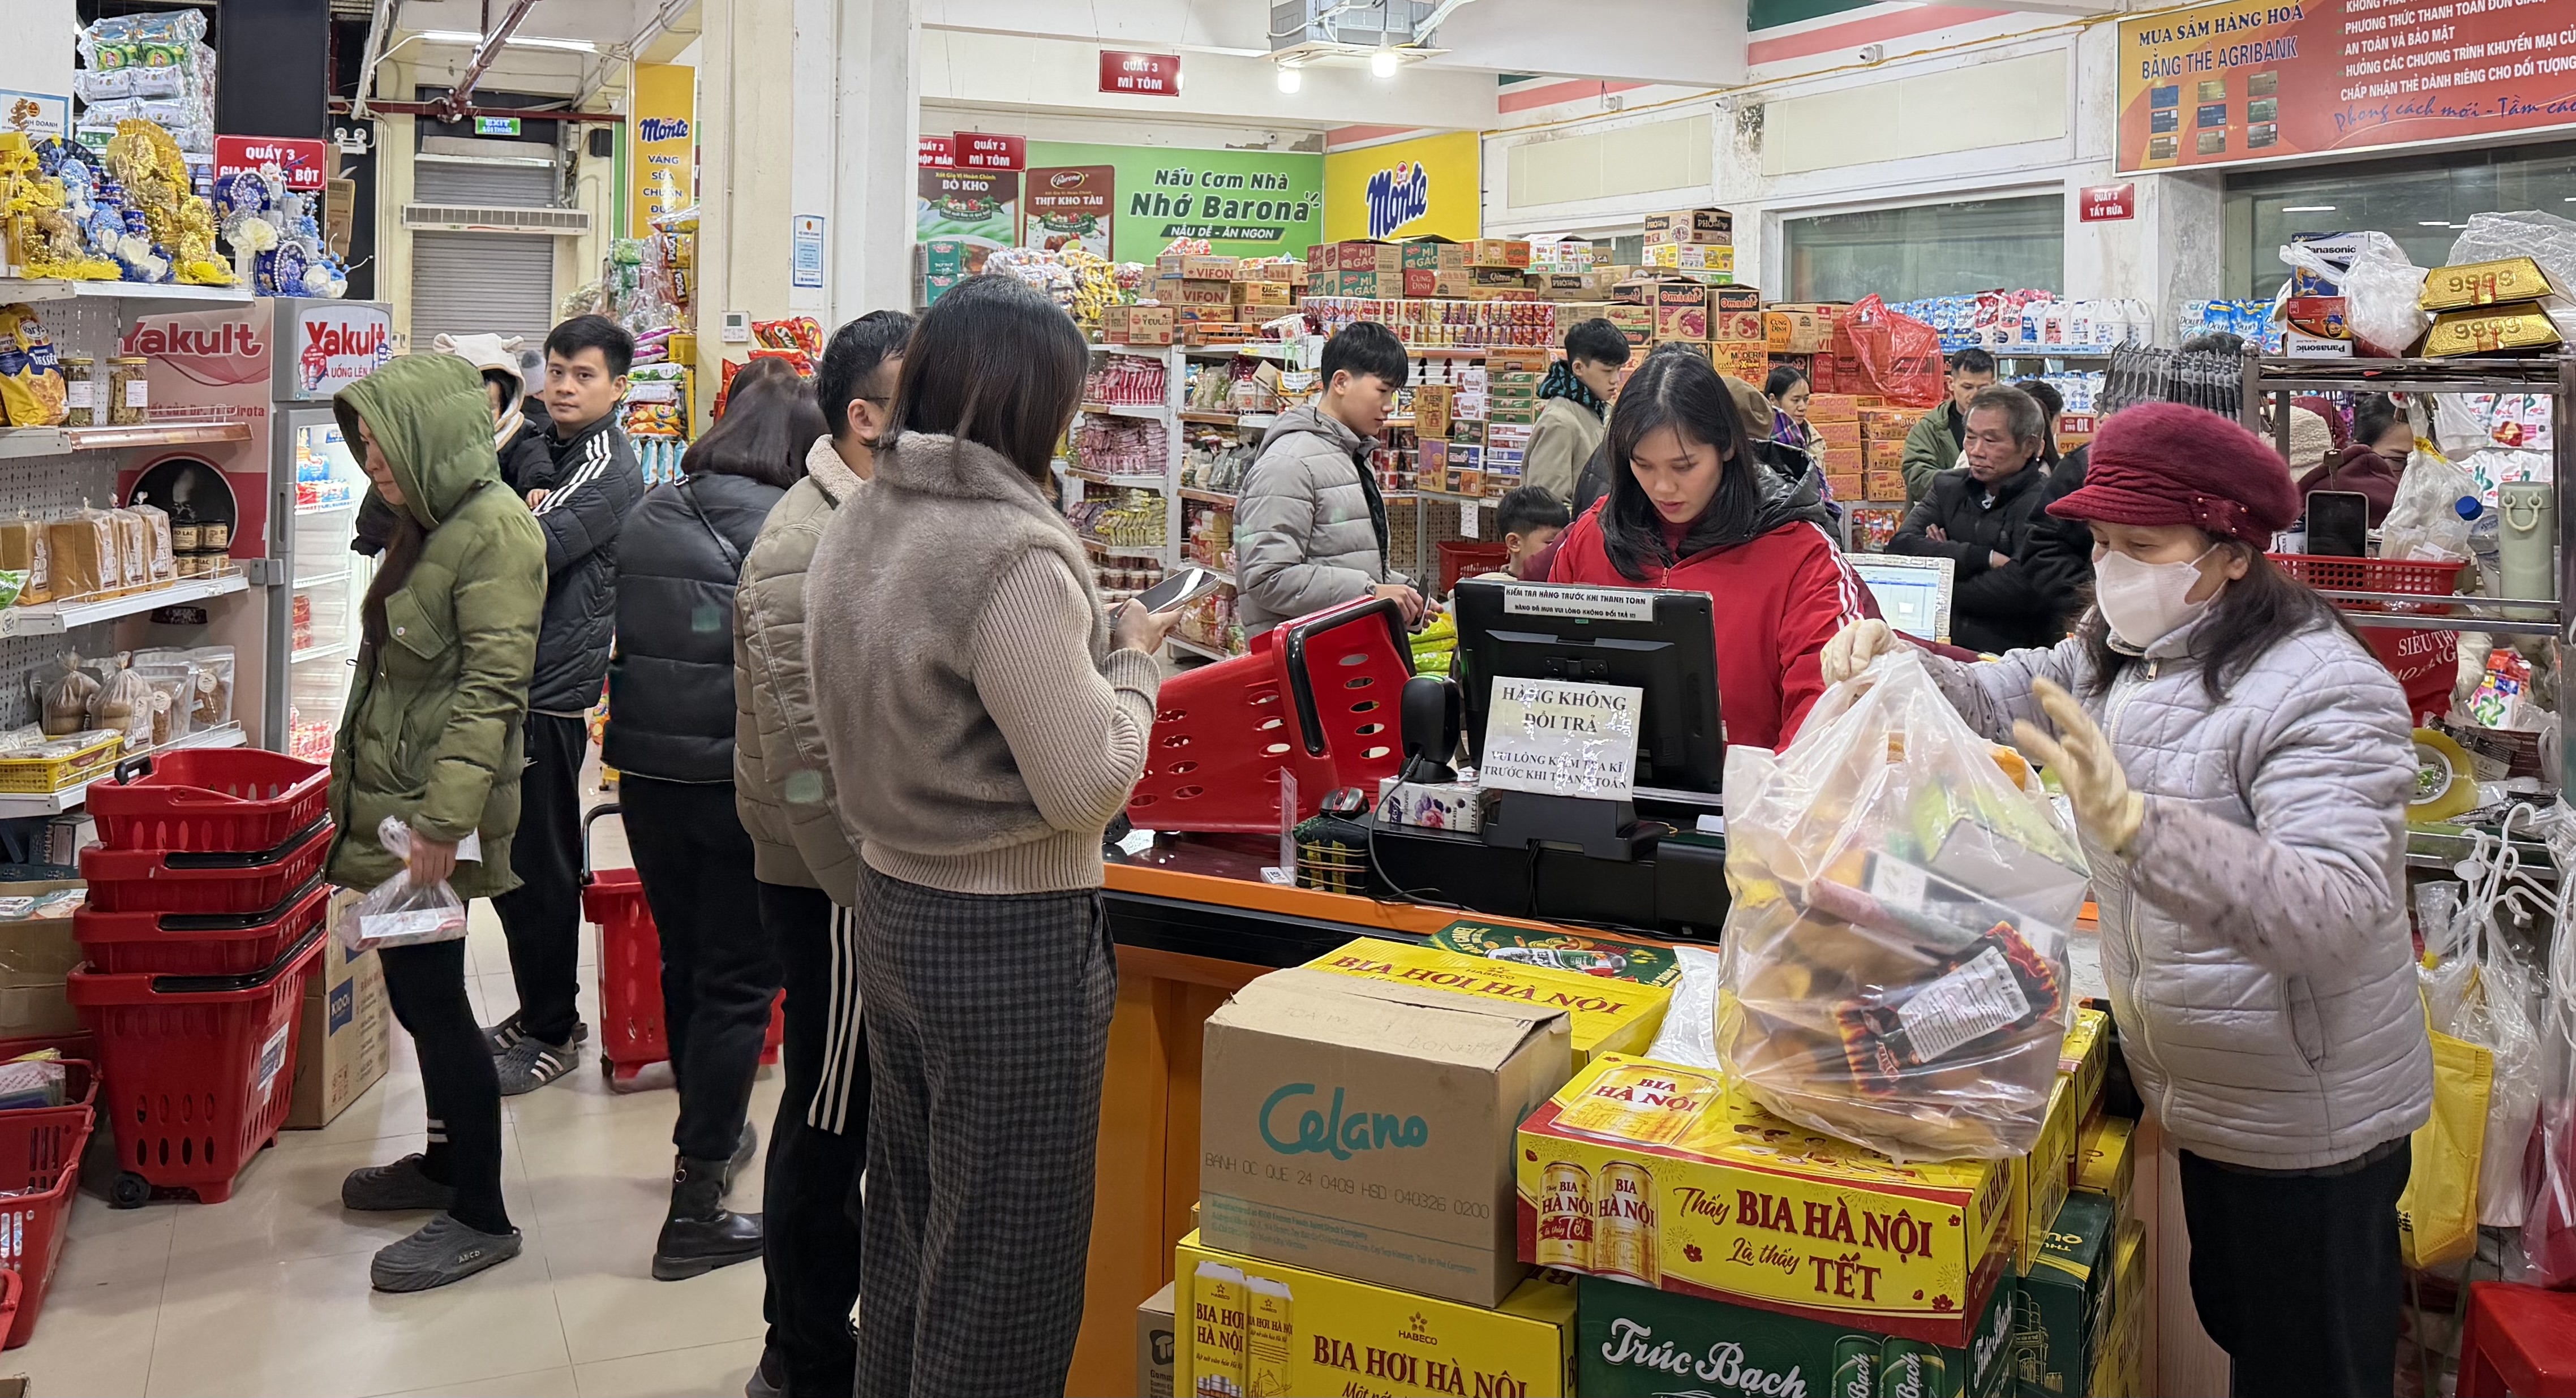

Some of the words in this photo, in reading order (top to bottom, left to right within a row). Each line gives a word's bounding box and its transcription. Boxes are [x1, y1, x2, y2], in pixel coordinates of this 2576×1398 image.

[2139, 28, 2173, 46] MUA
[2177, 15, 2209, 40] SẮM
[2214, 12, 2262, 34] HÀNG
[2267, 2, 2303, 24] HOÁ
[2345, 16, 2386, 35] PHƯƠNG
[2388, 9, 2415, 27] THỨC
[2418, 5, 2453, 22] THANH
[2345, 42, 2359, 55] AN
[2362, 36, 2389, 53] TOÀN
[2391, 31, 2405, 48] VÀ
[2408, 27, 2429, 46] BẢO
[2432, 24, 2455, 44] MẬT
[2142, 48, 2181, 80] BẰNG
[2186, 41, 2213, 72] THẺ
[2217, 35, 2298, 68] AGRIBANK
[2346, 58, 2381, 77] HƯỞNG
[2383, 55, 2405, 71] CÁC
[2407, 49, 2450, 68] CHƯƠNG
[2453, 43, 2484, 61] TRÌNH
[2487, 32, 2532, 56] KHUYẾN
[2535, 33, 2557, 51] MẠI
[1152, 63, 1158, 72] 3
[2341, 81, 2367, 101] CHẤP
[2369, 80, 2398, 99] NHẬN
[2399, 73, 2419, 93] THẺ
[2422, 73, 2451, 91] DÀNH
[2454, 68, 2485, 86] RIÊNG
[2488, 65, 2511, 81] CHO
[2514, 56, 2534, 77] ĐỐI
[2536, 55, 2576, 76] TƯỢNG
[1118, 75, 1133, 88] MÌ
[1137, 77, 1162, 90] TÔM
[2334, 104, 2389, 132] Phong
[2396, 96, 2436, 115] cách
[2441, 102, 2479, 118] mới
[2498, 94, 2539, 118] Tầm
[639, 118, 688, 141] Monte
[286, 149, 295, 160] 3
[649, 153, 679, 164] VÁNG
[969, 154, 984, 165] MÌ
[986, 155, 1010, 166] TÔM
[295, 167, 319, 184] BỘT
[942, 178, 959, 190] BÒ
[963, 181, 989, 191] KHO
[1155, 168, 1194, 186] Nấu
[1201, 172, 1243, 188] Cơm
[1251, 173, 1288, 190] Nhà
[1035, 197, 1056, 207] THỊT
[1083, 194, 1103, 205] TÀU
[1131, 192, 1193, 217] Nhớ
[1202, 196, 1309, 221] Barona
[1367, 163, 1427, 239] Monte
[1171, 222, 1195, 236] NẤU
[1222, 226, 1238, 238] ĂN
[1241, 229, 1273, 238] NGON
[1359, 246, 1371, 256] MÌ
[1422, 243, 1433, 255] MÌ
[1196, 268, 1234, 278] VIFON
[1353, 256, 1376, 268] GẠO
[1416, 256, 1438, 268] GẠO
[675, 273, 685, 296] POCA
[1354, 286, 1377, 296] GẠO
[1360, 274, 1372, 286] MÌ
[2449, 270, 2516, 292] 9999
[1156, 290, 1173, 301] VIFON
[1183, 291, 1223, 303] VIFON
[1660, 291, 1698, 303] Omachi
[1721, 298, 1753, 308] Omachi
[123, 322, 261, 356] Yakult
[305, 321, 385, 356] Yakult
[2454, 317, 2522, 339] 9999
[332, 363, 352, 377] UỐNG
[1901, 418, 1916, 427] BIG
[1506, 587, 1522, 596] KIỂM
[1539, 589, 1560, 599] HÀNG
[1562, 591, 1585, 600] TRƯỚC
[2398, 630, 2432, 656] SIÊU
[1502, 684, 1554, 704] HÀNG
[1558, 690, 1627, 711] KHÔNG
[1524, 710, 1556, 729] ĐỔI
[1561, 714, 1597, 733] TRẢ
[1492, 751, 1511, 761] VUI
[1514, 751, 1545, 765] LÒNG
[1484, 765, 1523, 778] TRƯỚC
[1526, 770, 1547, 780] KHI
[1329, 956, 1396, 974] BIA
[1401, 967, 1475, 989] HƠI
[1479, 978, 1539, 1000] HÀ
[1540, 991, 1628, 1014] NỘI
[1466, 969, 1514, 980] HABECO
[1637, 1078, 1676, 1092] BIA
[1592, 1086, 1634, 1102] HÀ
[1639, 1093, 1699, 1112] NỘI
[1260, 1082, 1428, 1161] Celano
[1206, 1152, 1237, 1172] BANH
[1266, 1164, 1289, 1181] QUE
[1297, 1171, 1312, 1186] 24
[1321, 1175, 1354, 1194] 0409
[1361, 1182, 1386, 1199] HSD
[1394, 1189, 1446, 1212] 040326
[1454, 1200, 1489, 1219] 0200
[1560, 1181, 1578, 1193] BIA
[1615, 1178, 1638, 1194] BIA
[1542, 1192, 1564, 1215] HÀ
[1567, 1195, 1594, 1218] NỘI
[1598, 1194, 1622, 1218] HÀ
[1624, 1199, 1655, 1229] NỘI
[1673, 1186, 1731, 1226] Thấy
[1736, 1189, 1795, 1235] BIA
[1804, 1196, 1861, 1246] HÀ
[1864, 1207, 1932, 1263] NỘI
[1726, 1237, 1755, 1266] Là
[1761, 1245, 1801, 1276] thấy
[1808, 1251, 1881, 1304] TẾT
[1196, 1302, 1218, 1323] BIA
[1221, 1308, 1244, 1330] HƠI
[1257, 1318, 1269, 1330] HƠI
[1272, 1319, 1282, 1332] HÀ
[1197, 1323, 1216, 1346] HÀ
[1220, 1330, 1243, 1356] NỘI
[1399, 1330, 1437, 1345] HABECO
[1313, 1335, 1359, 1373] BIA
[1366, 1347, 1418, 1386] HƠI
[1426, 1358, 1467, 1396] HÀ
[1602, 1318, 1691, 1375] Trúc
[1695, 1341, 1807, 1398] Bạch
